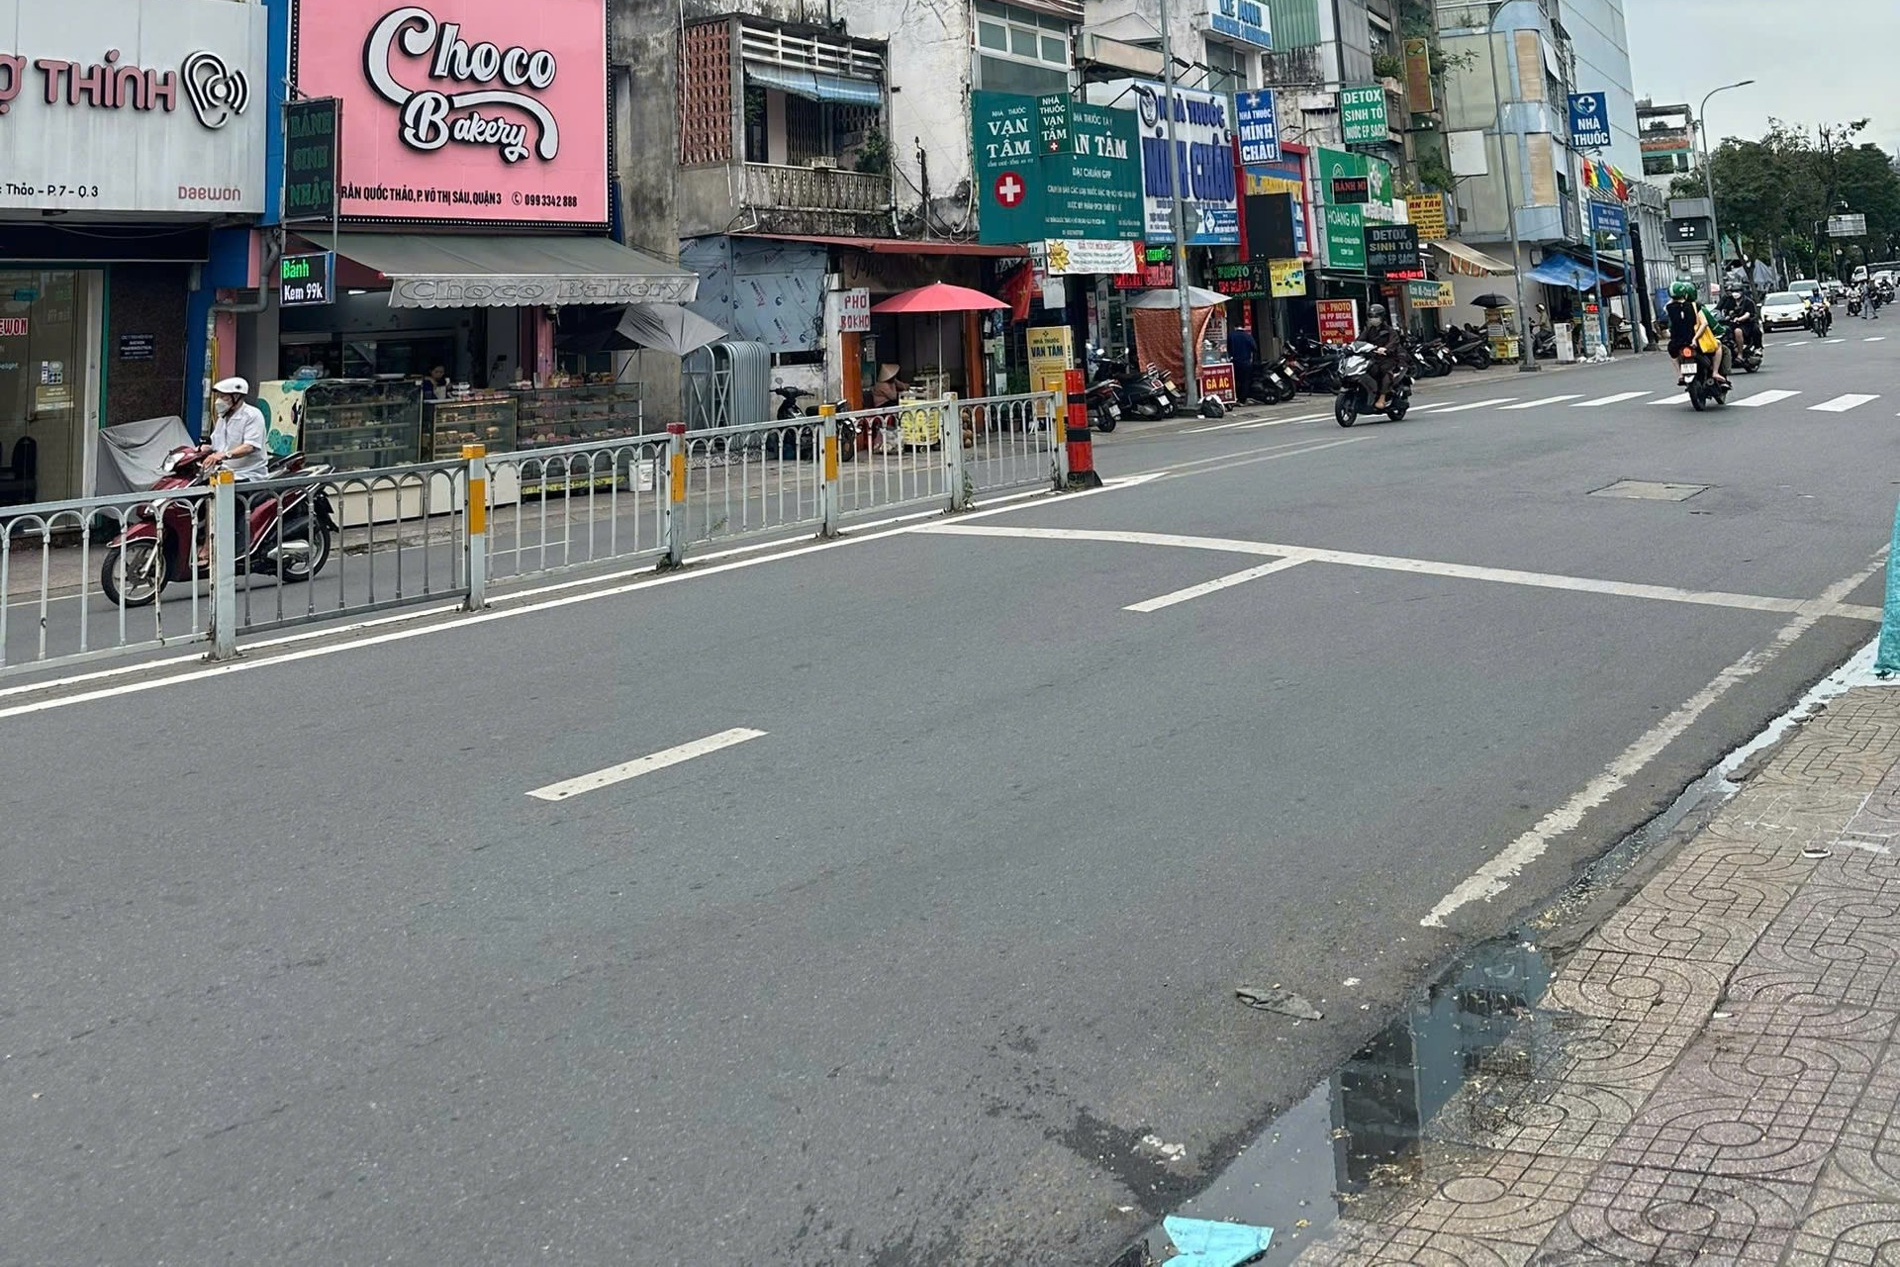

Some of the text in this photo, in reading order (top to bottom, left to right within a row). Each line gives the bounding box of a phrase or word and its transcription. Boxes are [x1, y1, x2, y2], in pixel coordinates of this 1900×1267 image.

[363, 6, 557, 107] Choco
[35, 48, 177, 113] THÍNH
[1042, 95, 1060, 105] NHÀ
[1343, 89, 1381, 104] DETOX
[1040, 104, 1066, 115] THUỐC
[1186, 96, 1225, 128] THUỐC
[1345, 103, 1383, 122] SINH TỐ
[400, 89, 529, 163] Bakery
[987, 118, 1028, 138] VẠN
[1043, 115, 1064, 128] VẠN
[1577, 116, 1601, 130] NHÀ
[1041, 127, 1067, 141] TÂM
[1573, 130, 1609, 146] THUỐC
[986, 139, 1032, 159] TÂM
[1095, 131, 1128, 160] TÂM
[1242, 141, 1275, 161] CHÂU
[1190, 133, 1236, 202] CHÂU
[6, 182, 35, 196] Thảo
[290, 176, 331, 210] NHẬT
[364, 183, 388, 201] QUỐC
[424, 186, 436, 202] VÕ
[438, 190, 451, 205] THỊ
[473, 190, 495, 206] QUẬN
[1335, 181, 1356, 191] BÁNH
[1327, 207, 1350, 226] HOÀNG
[1351, 214, 1360, 227] AN
[1369, 238, 1413, 251] SINH TỐ
[1373, 229, 1407, 241] DETOX
[282, 259, 310, 279] Bánh
[284, 282, 323, 301] Kem 99k
[399, 279, 693, 302] Choco Bakery
[1206, 375, 1229, 389] GÀ ÁC
